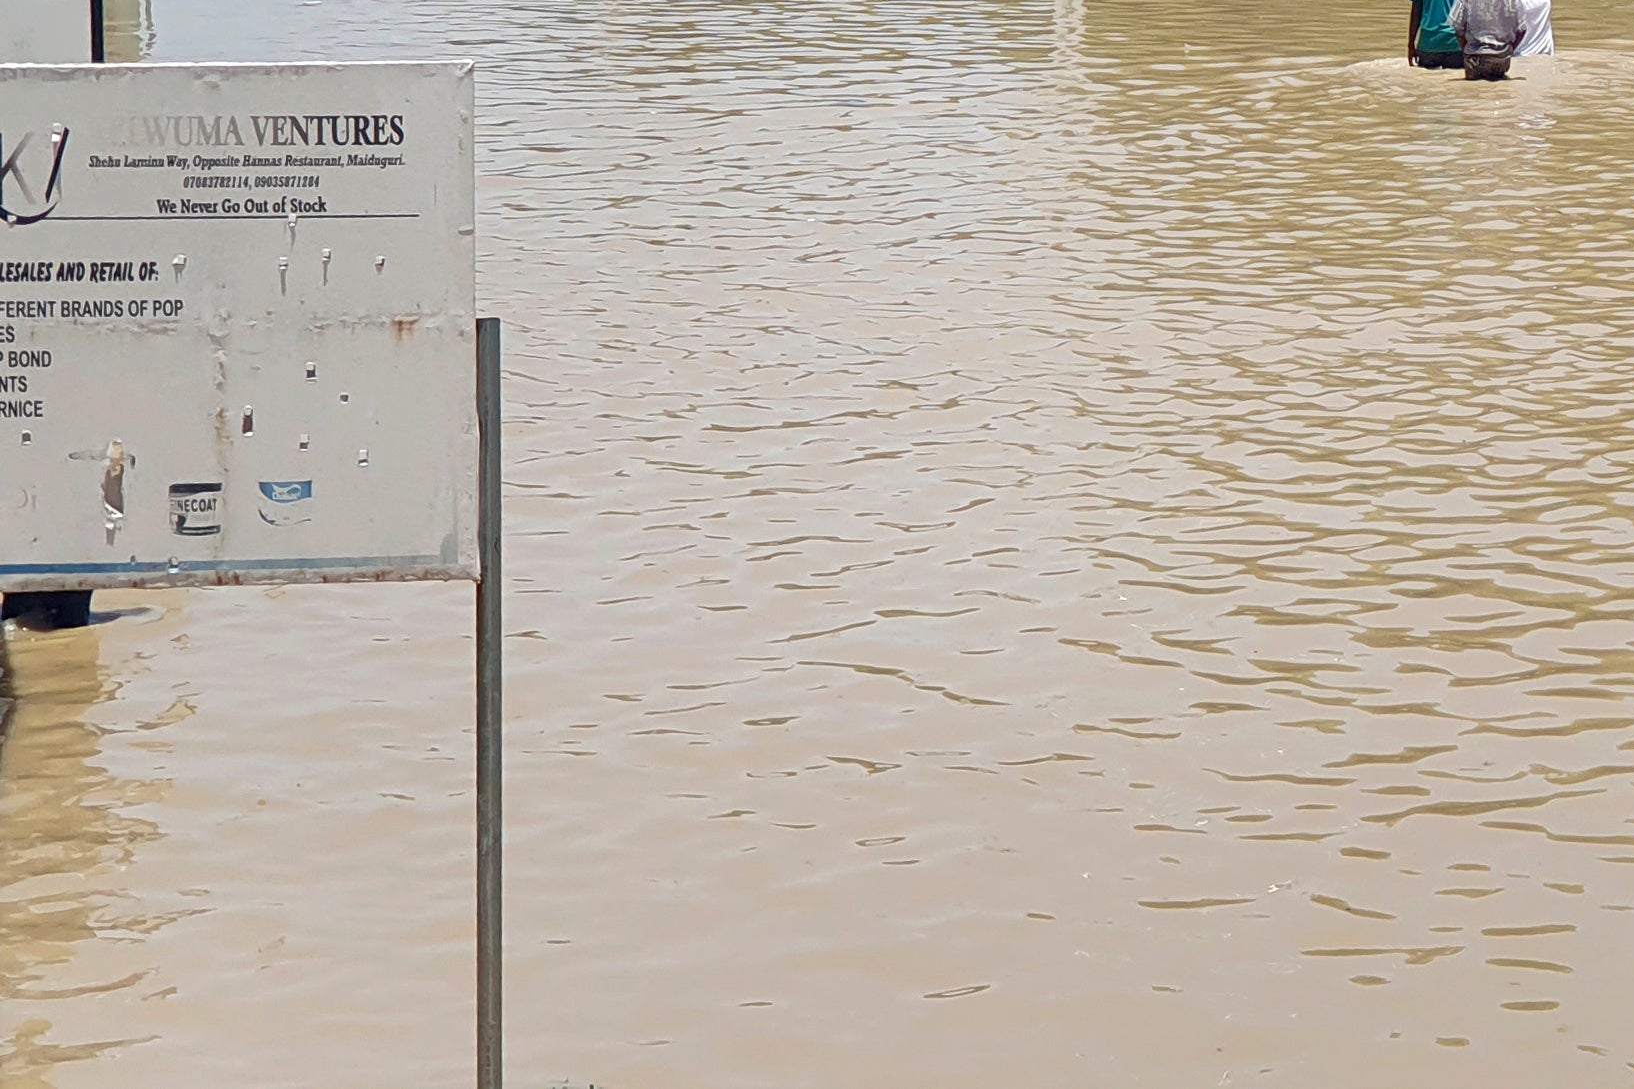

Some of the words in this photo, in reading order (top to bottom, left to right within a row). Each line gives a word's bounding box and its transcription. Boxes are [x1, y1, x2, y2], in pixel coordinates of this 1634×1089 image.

[129, 114, 244, 147] WUMA
[250, 114, 404, 147] VENTURES
[89, 155, 121, 168] Shehu
[166, 155, 190, 170] Way,
[193, 154, 240, 170] Opposite
[242, 155, 282, 167] Hannas
[285, 155, 344, 168] Restaurant,
[346, 154, 406, 169] Maiduguri.
[156, 199, 177, 214] We
[180, 198, 218, 214] Never
[221, 198, 240, 214] Go
[244, 198, 268, 213] Out
[272, 196, 287, 213] of
[290, 196, 327, 213] Stock
[56, 262, 86, 282] AND
[89, 261, 135, 283] RETAIL
[138, 261, 159, 281] OF:
[60, 300, 124, 318] BRANDS
[128, 299, 149, 317] OF
[152, 299, 184, 316] POP
[8, 350, 52, 368] BOND
